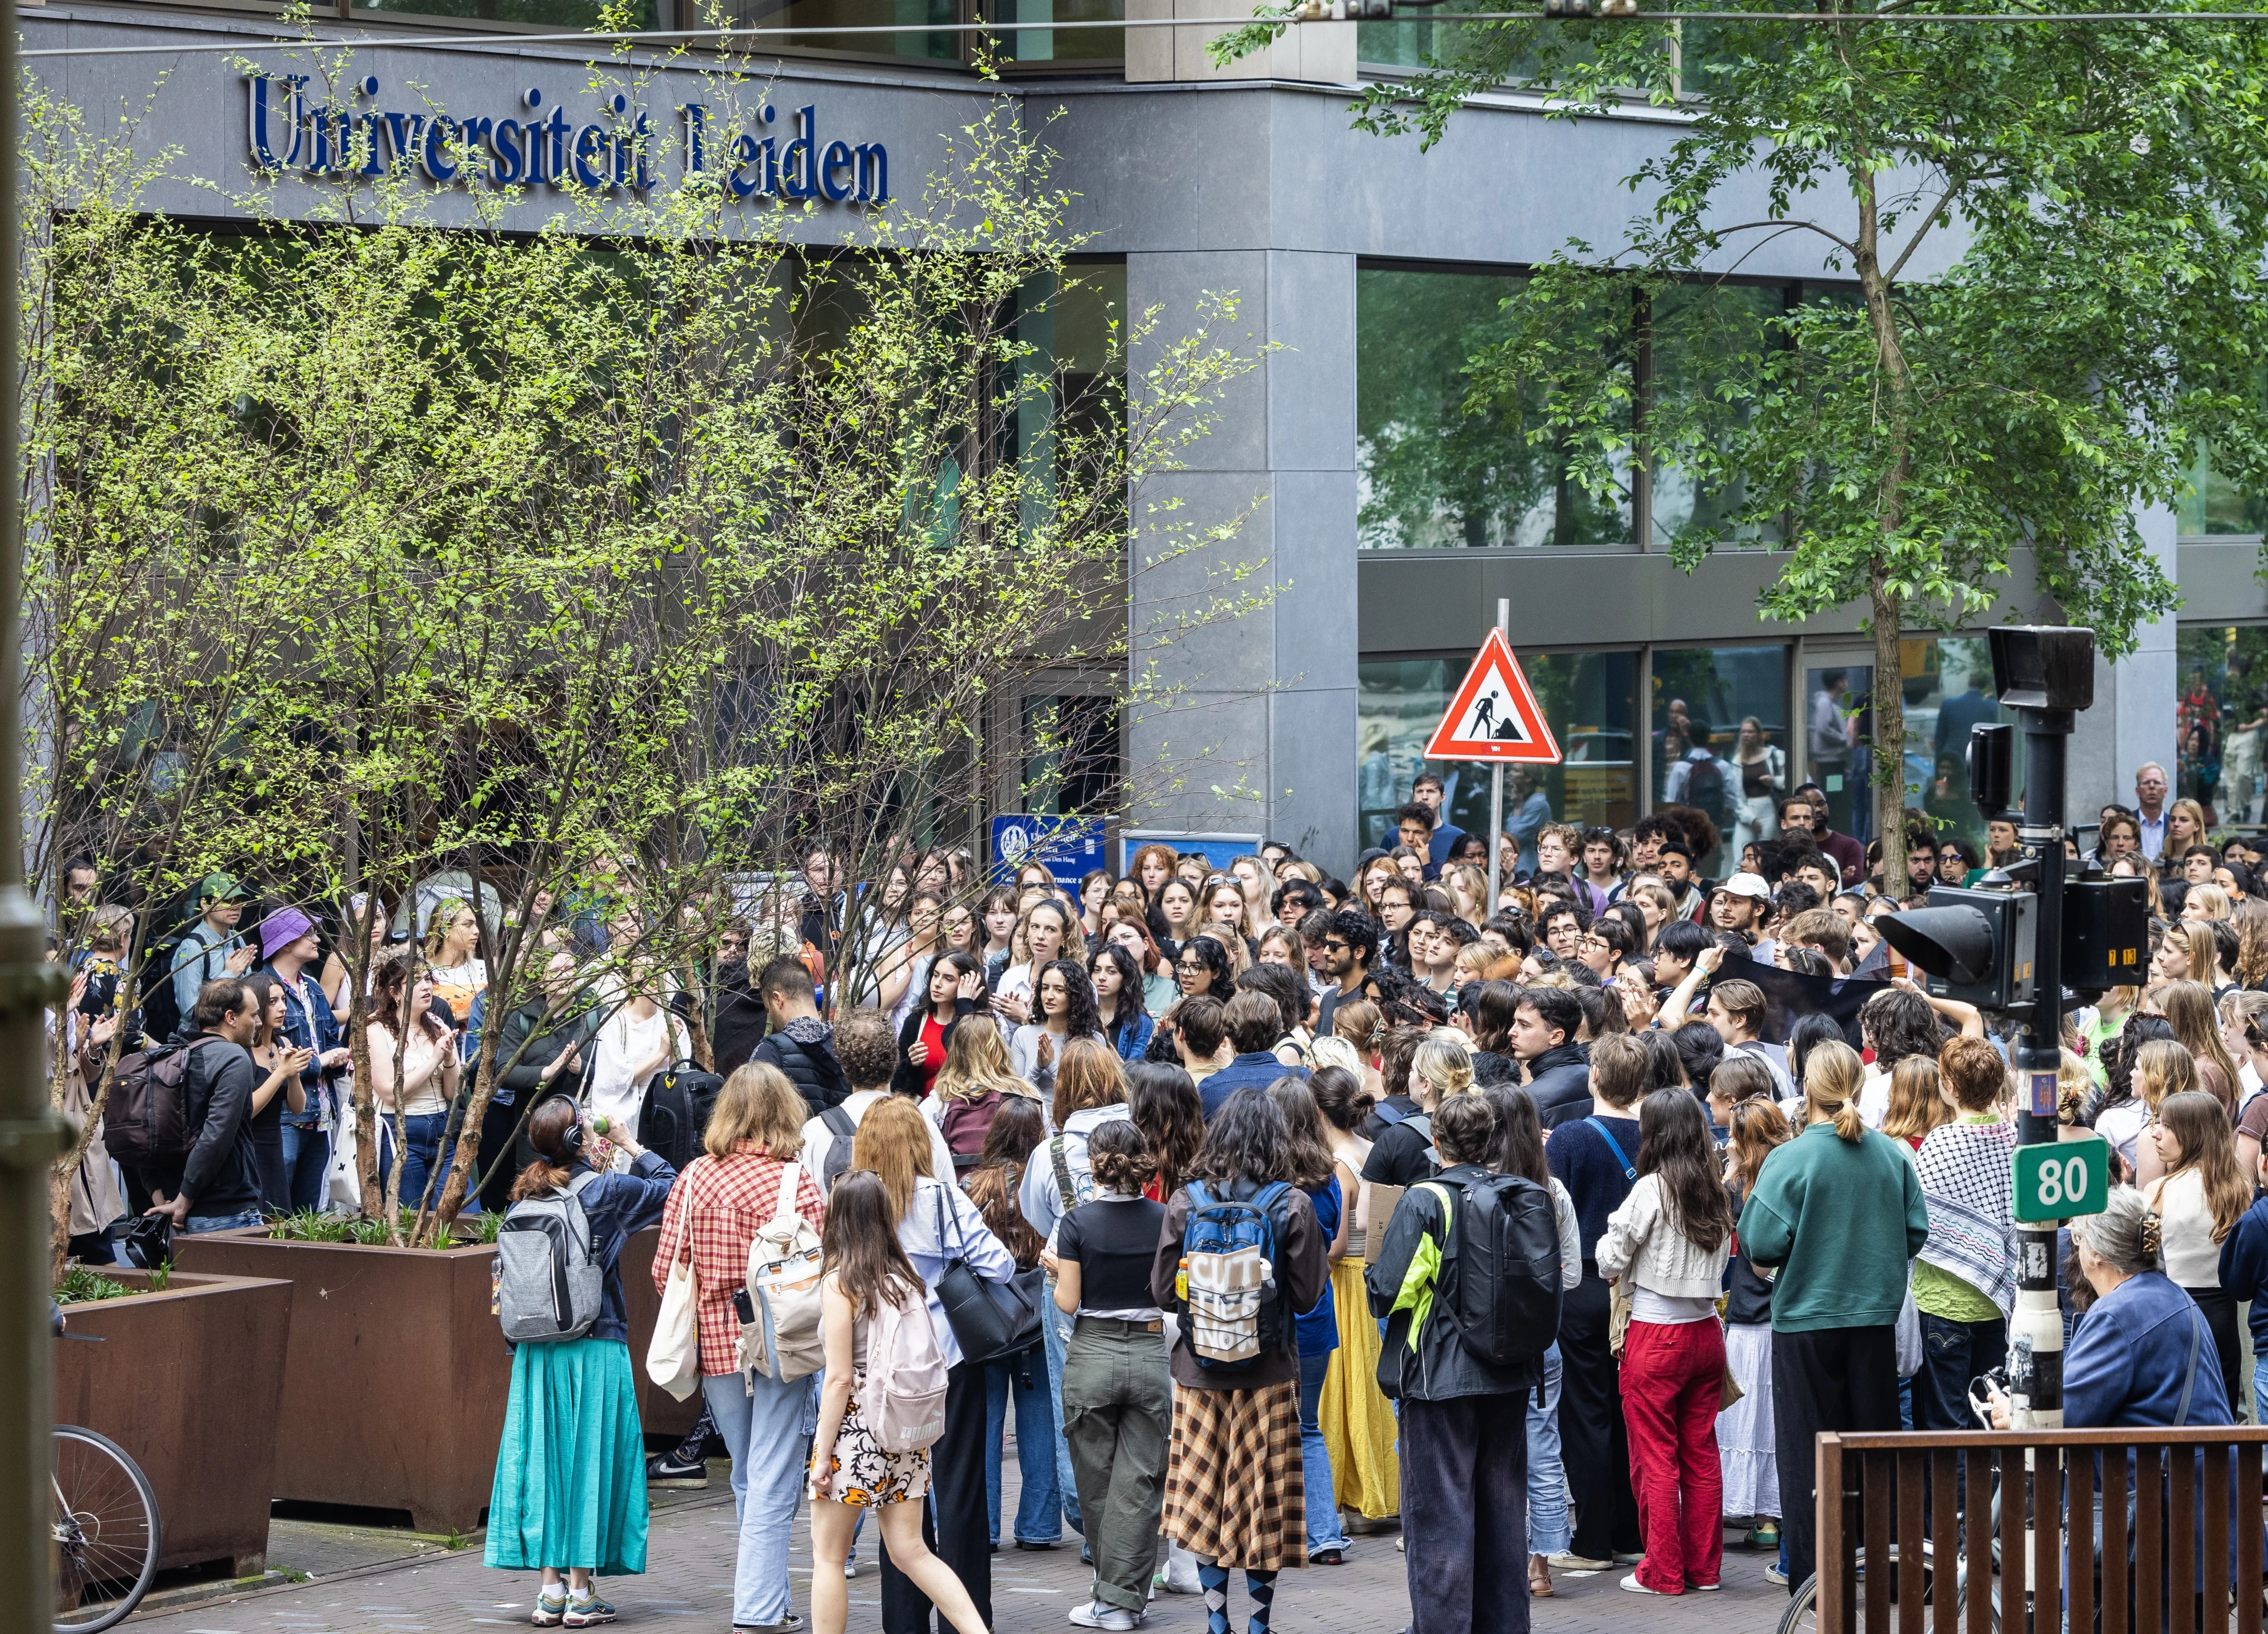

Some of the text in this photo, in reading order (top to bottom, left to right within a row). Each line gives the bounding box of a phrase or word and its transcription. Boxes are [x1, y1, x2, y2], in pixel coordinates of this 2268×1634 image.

[245, 72, 888, 202] Universiteit Leiden
[2110, 949, 2135, 965] 7 13
[2038, 1156, 2087, 1205] 80
[1192, 1253, 1260, 1293] CUT
[1197, 1290, 1259, 1321] TIES
[1197, 1319, 1257, 1354] NOW
[900, 1420, 940, 1442] PUMA
